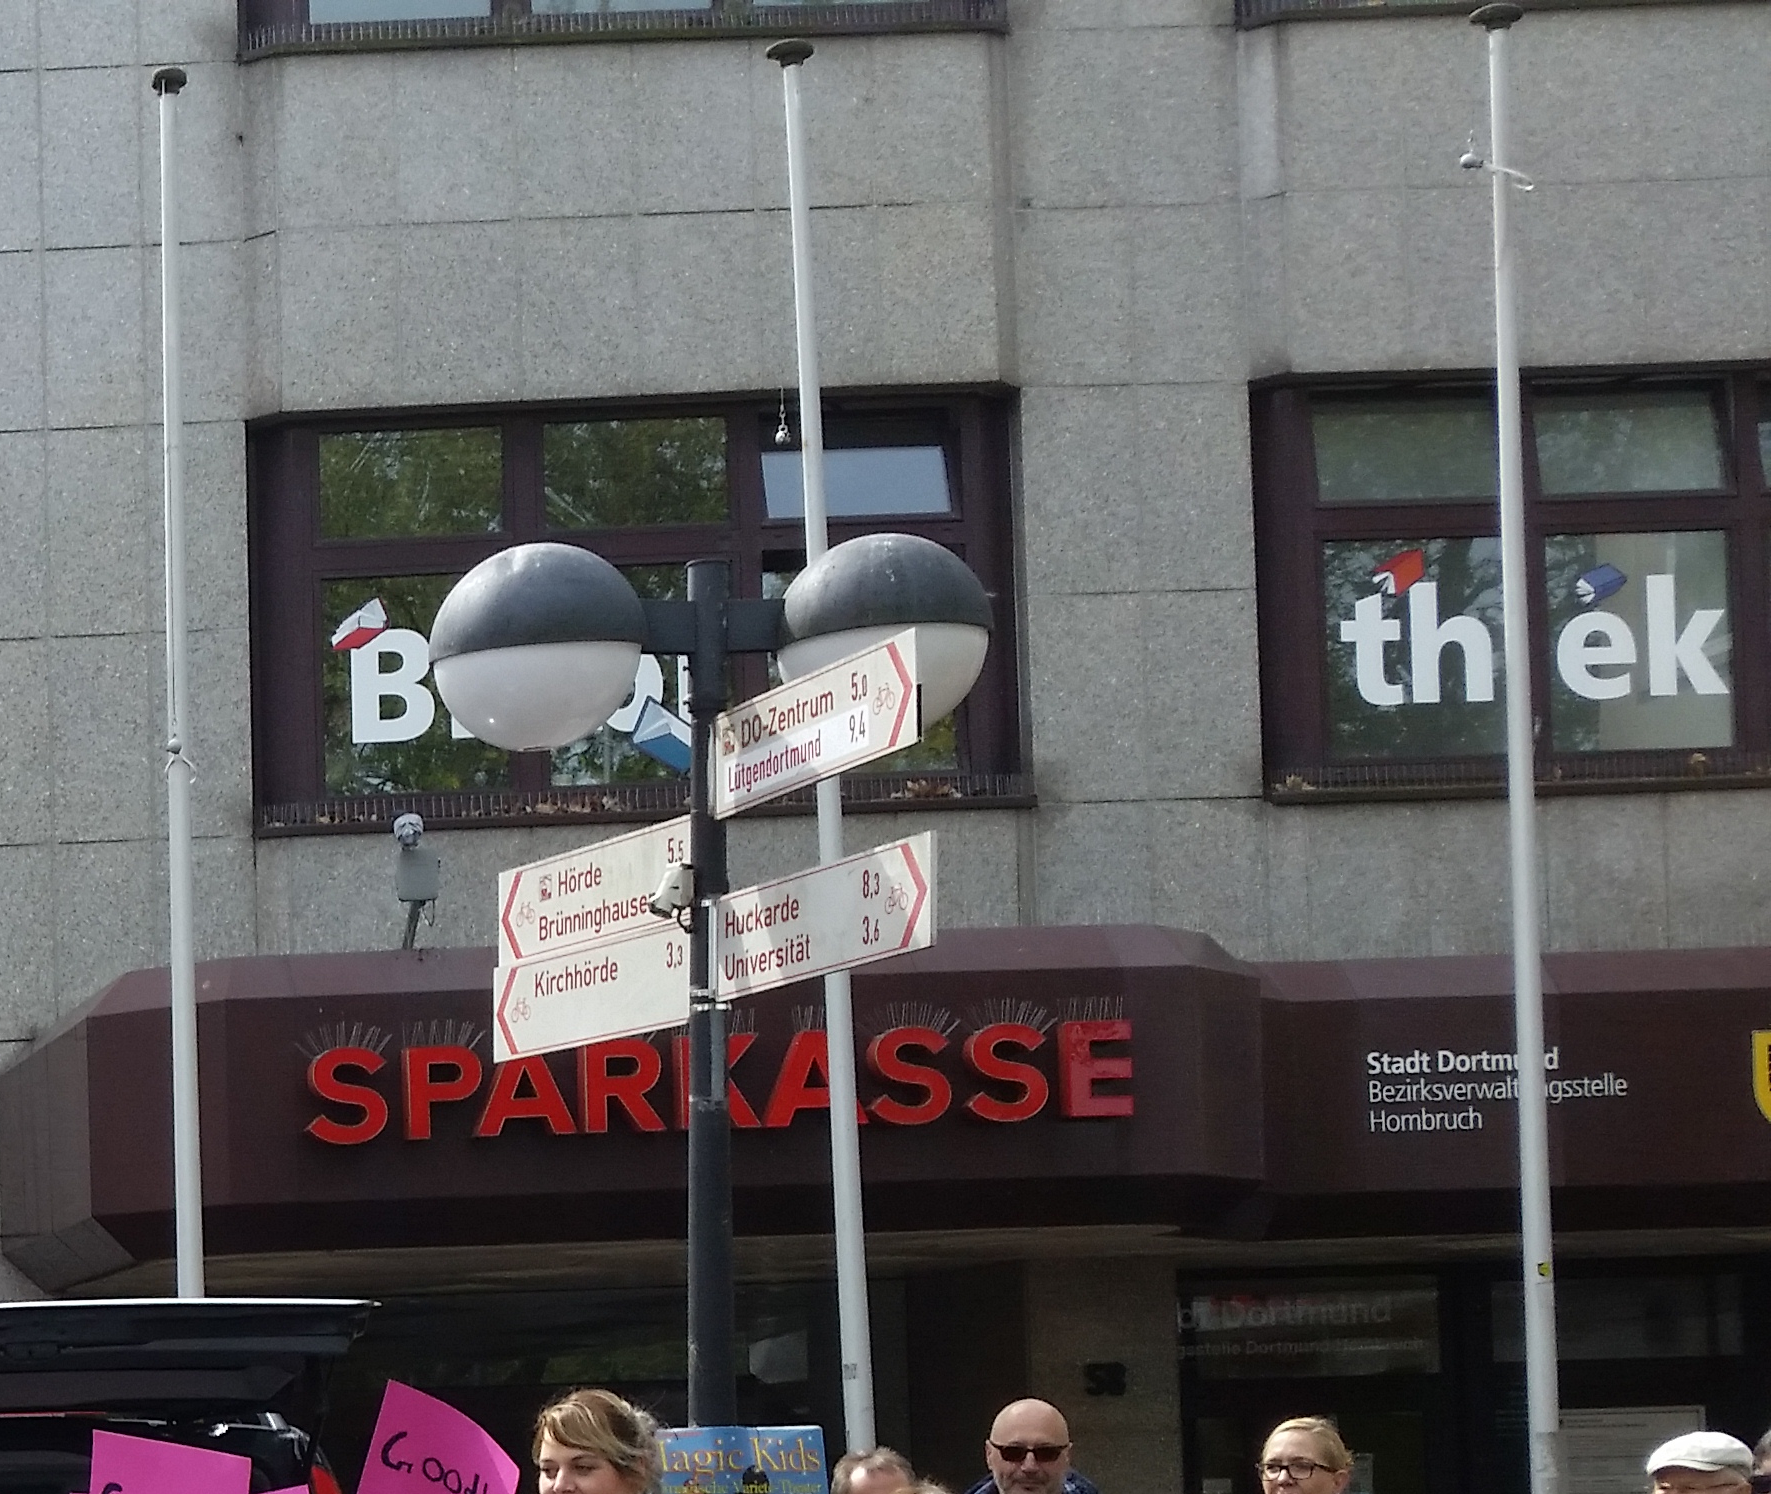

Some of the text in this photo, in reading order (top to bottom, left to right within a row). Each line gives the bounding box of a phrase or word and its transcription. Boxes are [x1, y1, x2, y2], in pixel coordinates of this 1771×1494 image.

[740, 671, 869, 749] DO-Zentrum 5,0
[727, 709, 866, 794] Lütgendortmund 9,4
[557, 861, 603, 898] Hörde
[538, 892, 656, 942] Brünninghause
[724, 868, 880, 939] Huckarde 8,3
[724, 915, 880, 982] Universität 3,6
[534, 956, 619, 999] Kirchhörde
[304, 1018, 1134, 1145] SPARKASSE
[1366, 1046, 1559, 1076] Stadt Dortmd
[1368, 1073, 1629, 1105] Bezirksverwaltgsstelle
[1369, 1107, 1483, 1132] Hombruch
[749, 1436, 822, 1473] Kids
